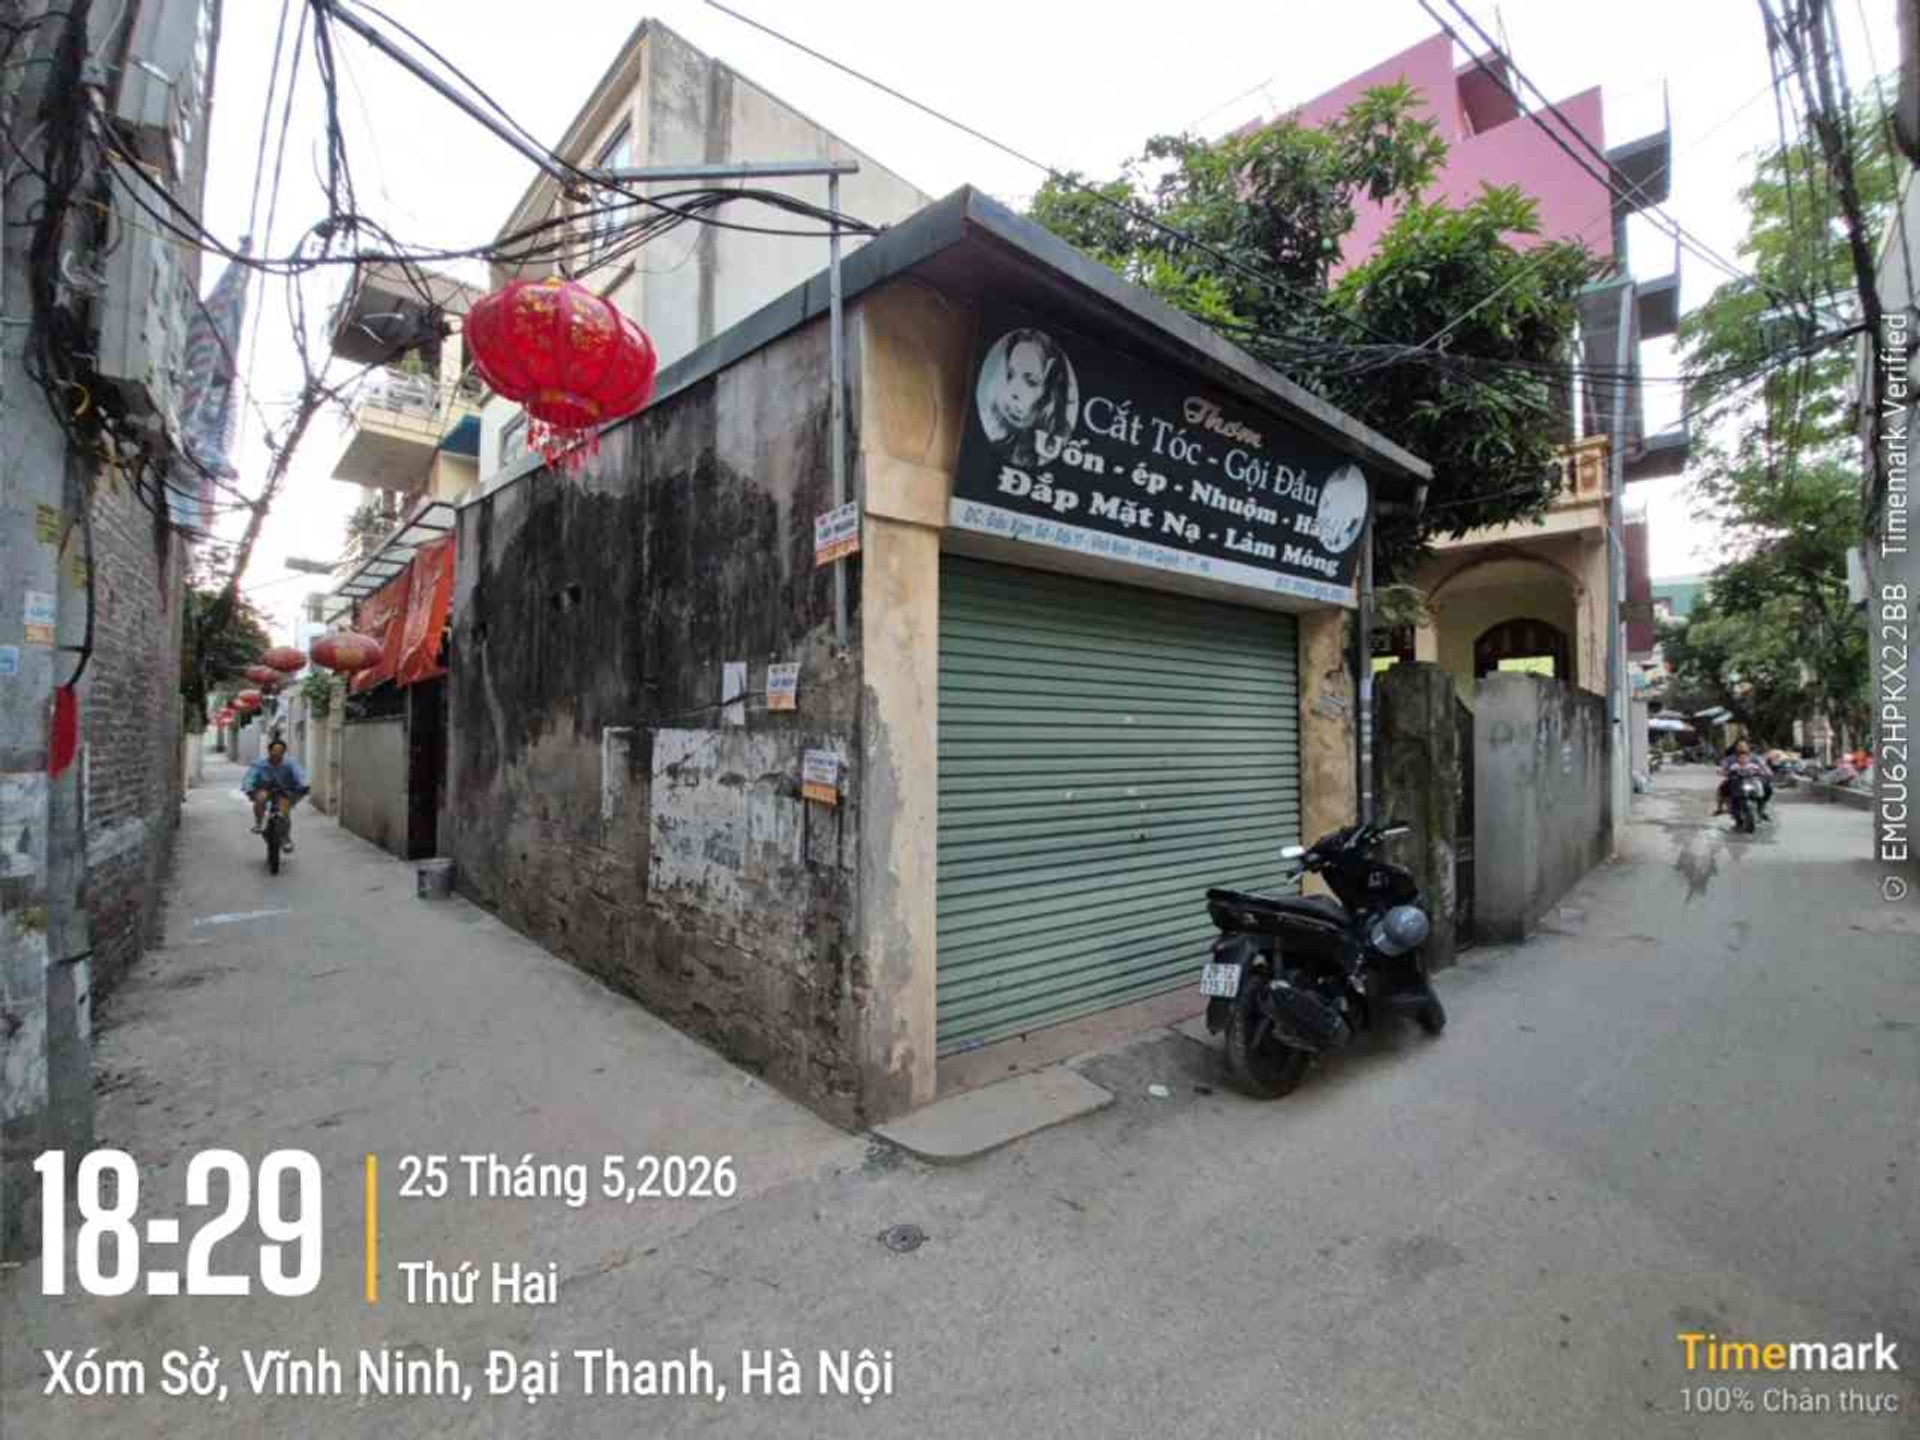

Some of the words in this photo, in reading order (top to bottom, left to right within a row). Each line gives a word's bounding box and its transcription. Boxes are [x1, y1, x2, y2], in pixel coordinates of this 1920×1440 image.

[1034, 428, 1105, 475] Uốn
[1188, 479, 1278, 526] Nhuộm
[1083, 396, 1144, 446] Cắt
[1151, 416, 1202, 466] Tóc
[1224, 448, 1271, 493] Gội
[1088, 490, 1155, 529] Mặt
[1160, 509, 1201, 544] Nạ
[1282, 542, 1342, 578] Móng
